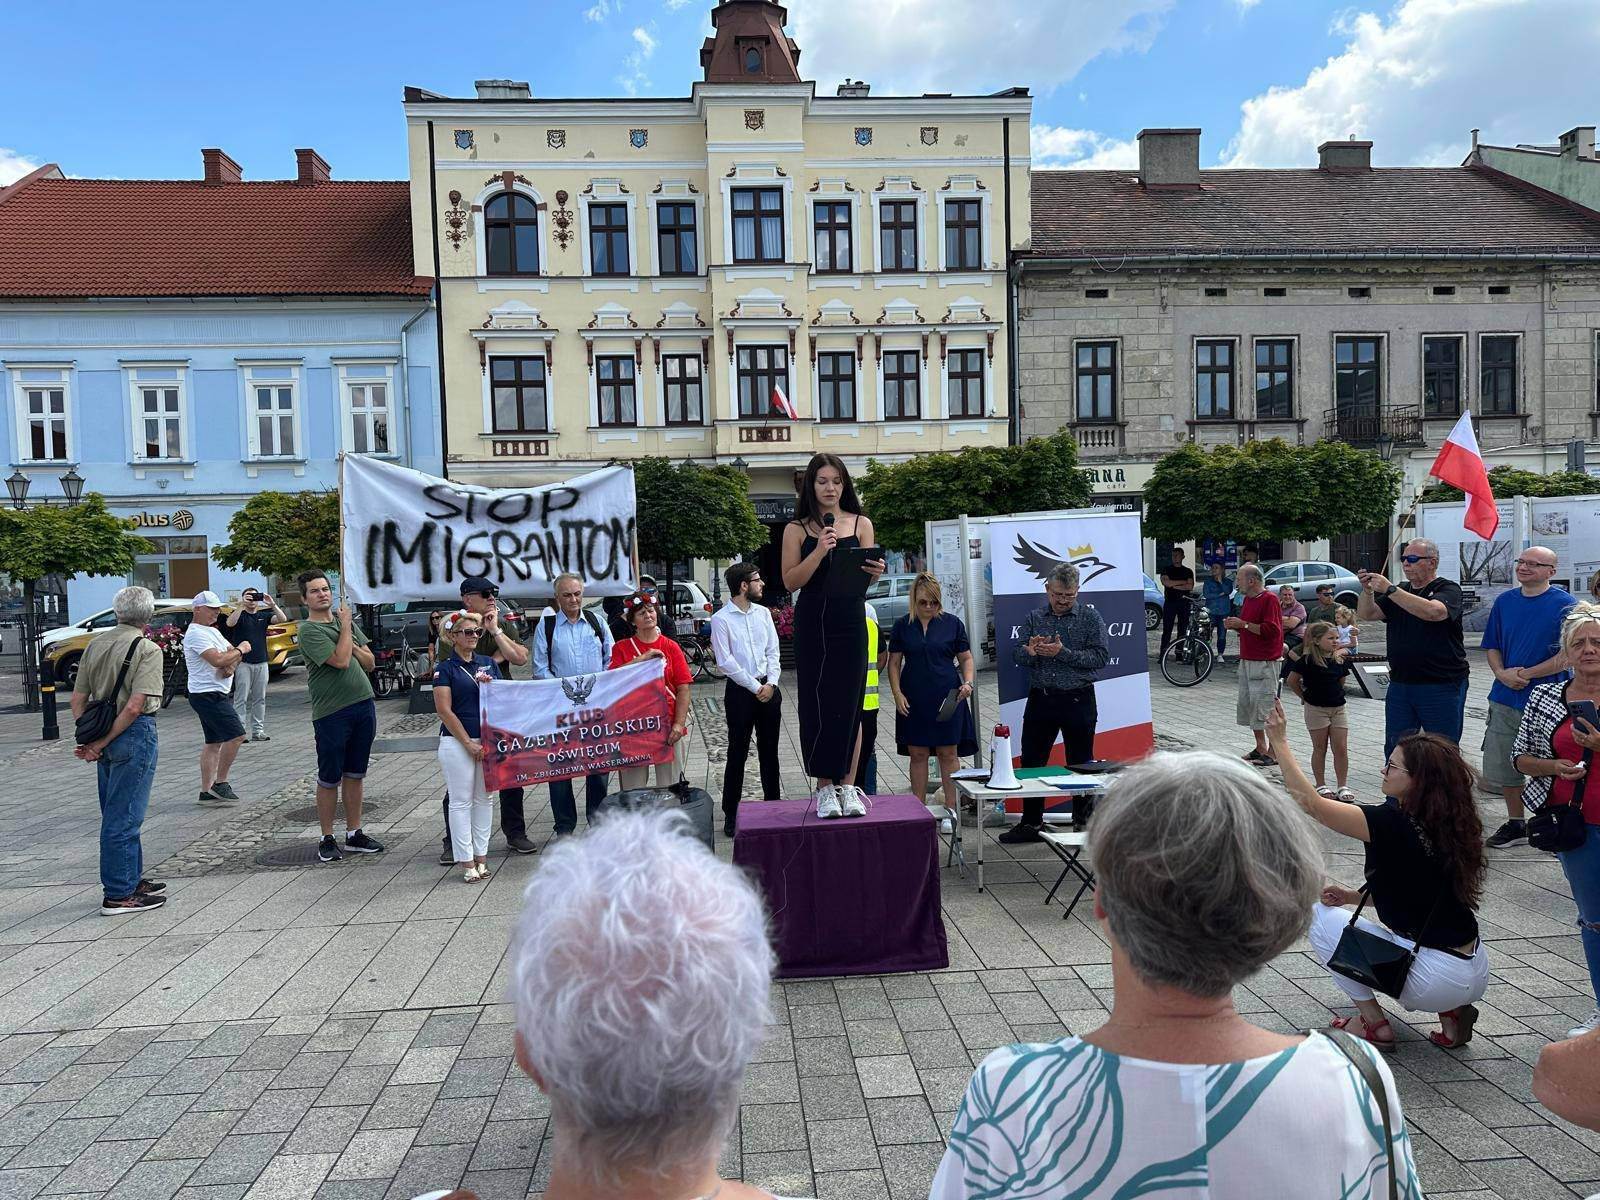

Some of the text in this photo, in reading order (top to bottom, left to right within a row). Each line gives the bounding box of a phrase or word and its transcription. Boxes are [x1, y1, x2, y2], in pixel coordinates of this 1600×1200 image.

[1090, 468, 1125, 483] ANA
[423, 485, 580, 528] STOP
[365, 517, 635, 589] IMIGRANTOM
[555, 708, 604, 728] KLUB
[497, 715, 662, 753] GAZETY POLSKIEJ
[547, 741, 621, 763] OŚWIĘCIM
[516, 753, 652, 782] IM. ZBIGNIEWA WASSERMANNA
